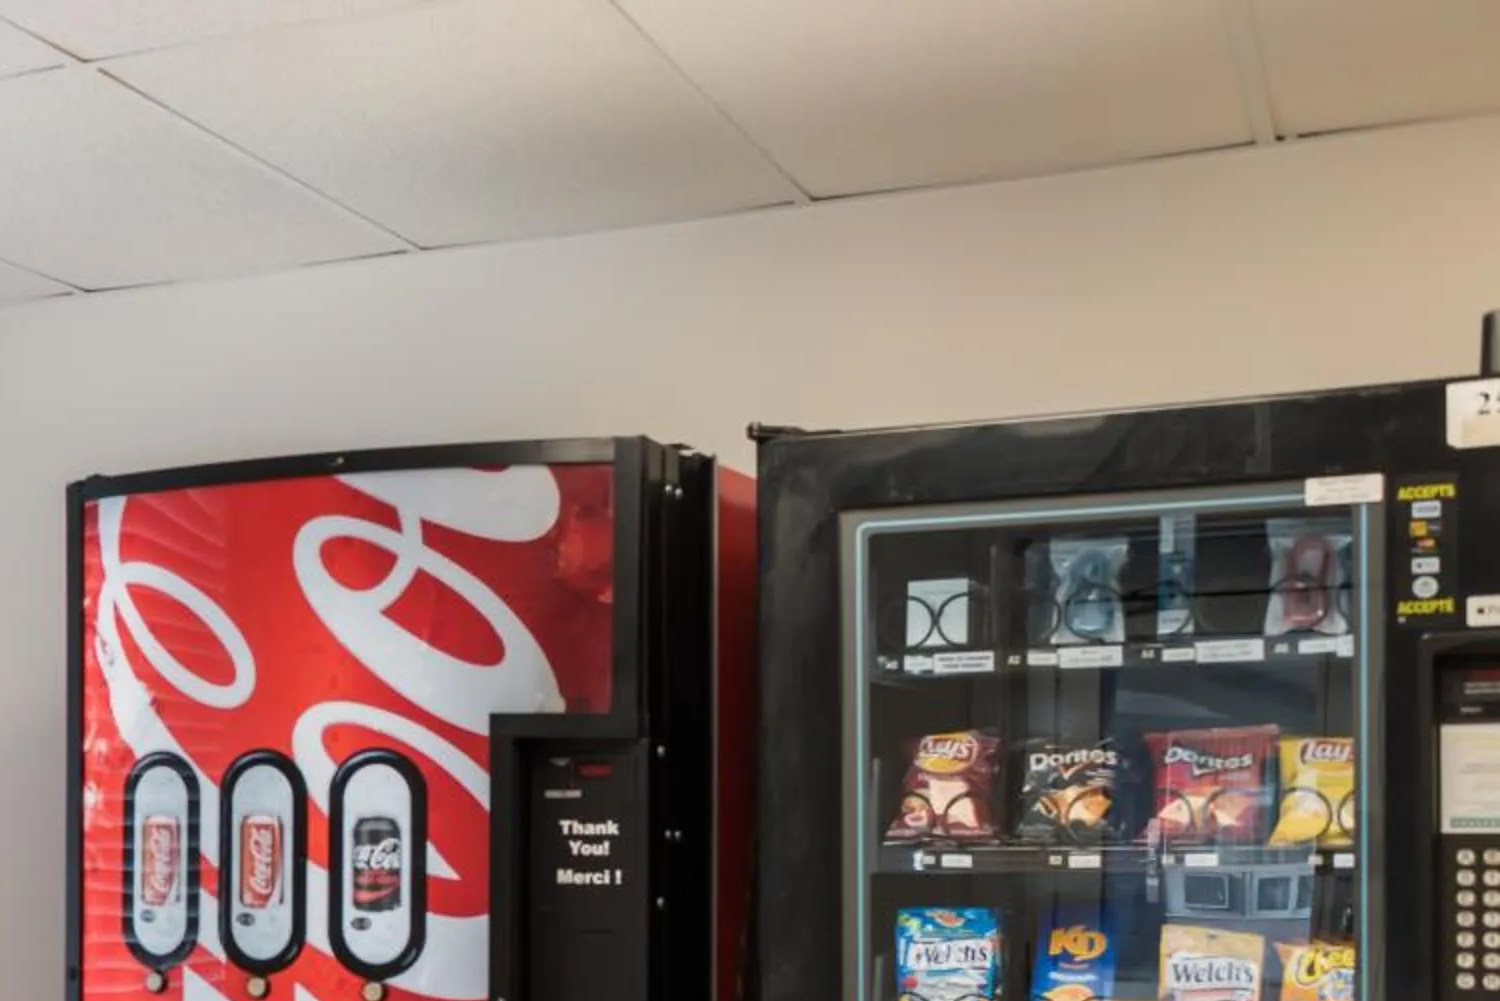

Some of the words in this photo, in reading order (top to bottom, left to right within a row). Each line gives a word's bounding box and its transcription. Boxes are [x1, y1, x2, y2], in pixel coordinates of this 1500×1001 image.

[1475, 391, 1500, 416] 2
[1029, 748, 1119, 771] Doritos
[1164, 746, 1253, 769] Doritos
[558, 819, 620, 836] Thank
[568, 839, 611, 856] You!
[556, 868, 611, 885] Merci
[1171, 961, 1255, 984] Welch's
